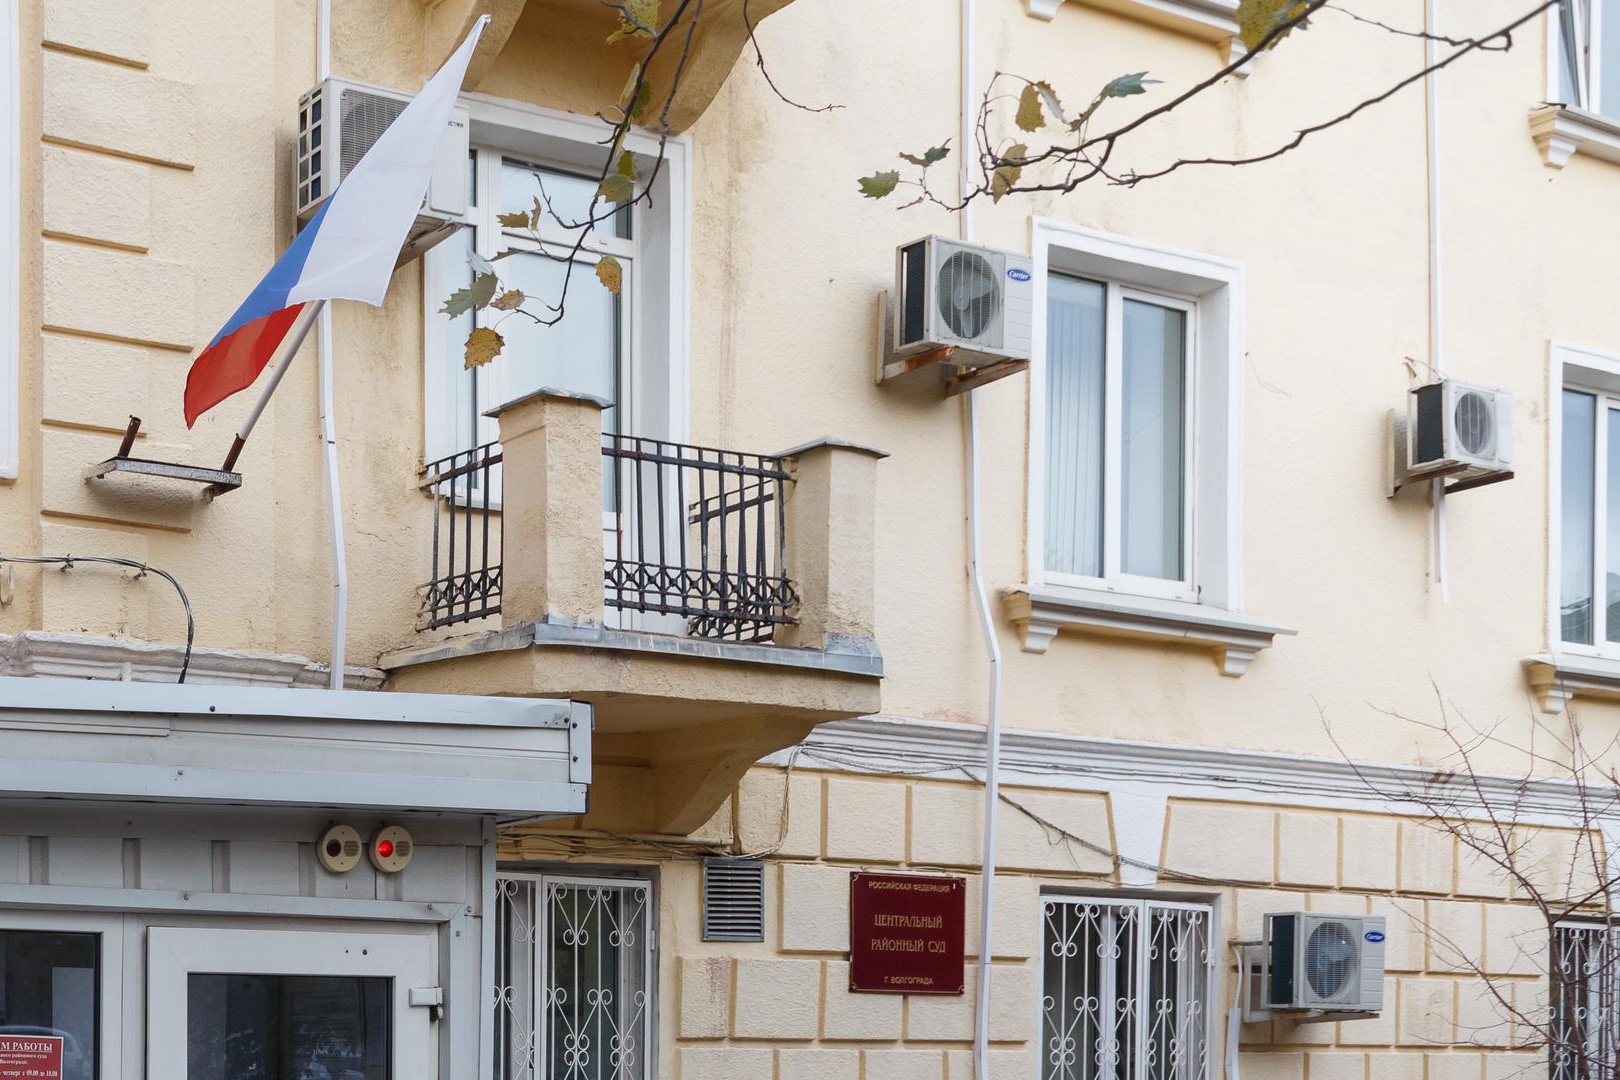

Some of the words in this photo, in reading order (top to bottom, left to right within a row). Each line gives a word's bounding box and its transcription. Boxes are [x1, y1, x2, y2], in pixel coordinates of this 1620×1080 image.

[868, 881, 912, 890] РОССИЙСКАЯ
[912, 884, 950, 893] ФЕДЕРАЦИЯ
[874, 914, 943, 928] ЦЕНТРАЛЬНЫЙ
[871, 938, 924, 952] РАЙОННЫЙ
[928, 940, 946, 953] СУД
[890, 976, 934, 985] ВОЛГОГРАДА
[12, 1042, 53, 1052] РАБОТЫ
